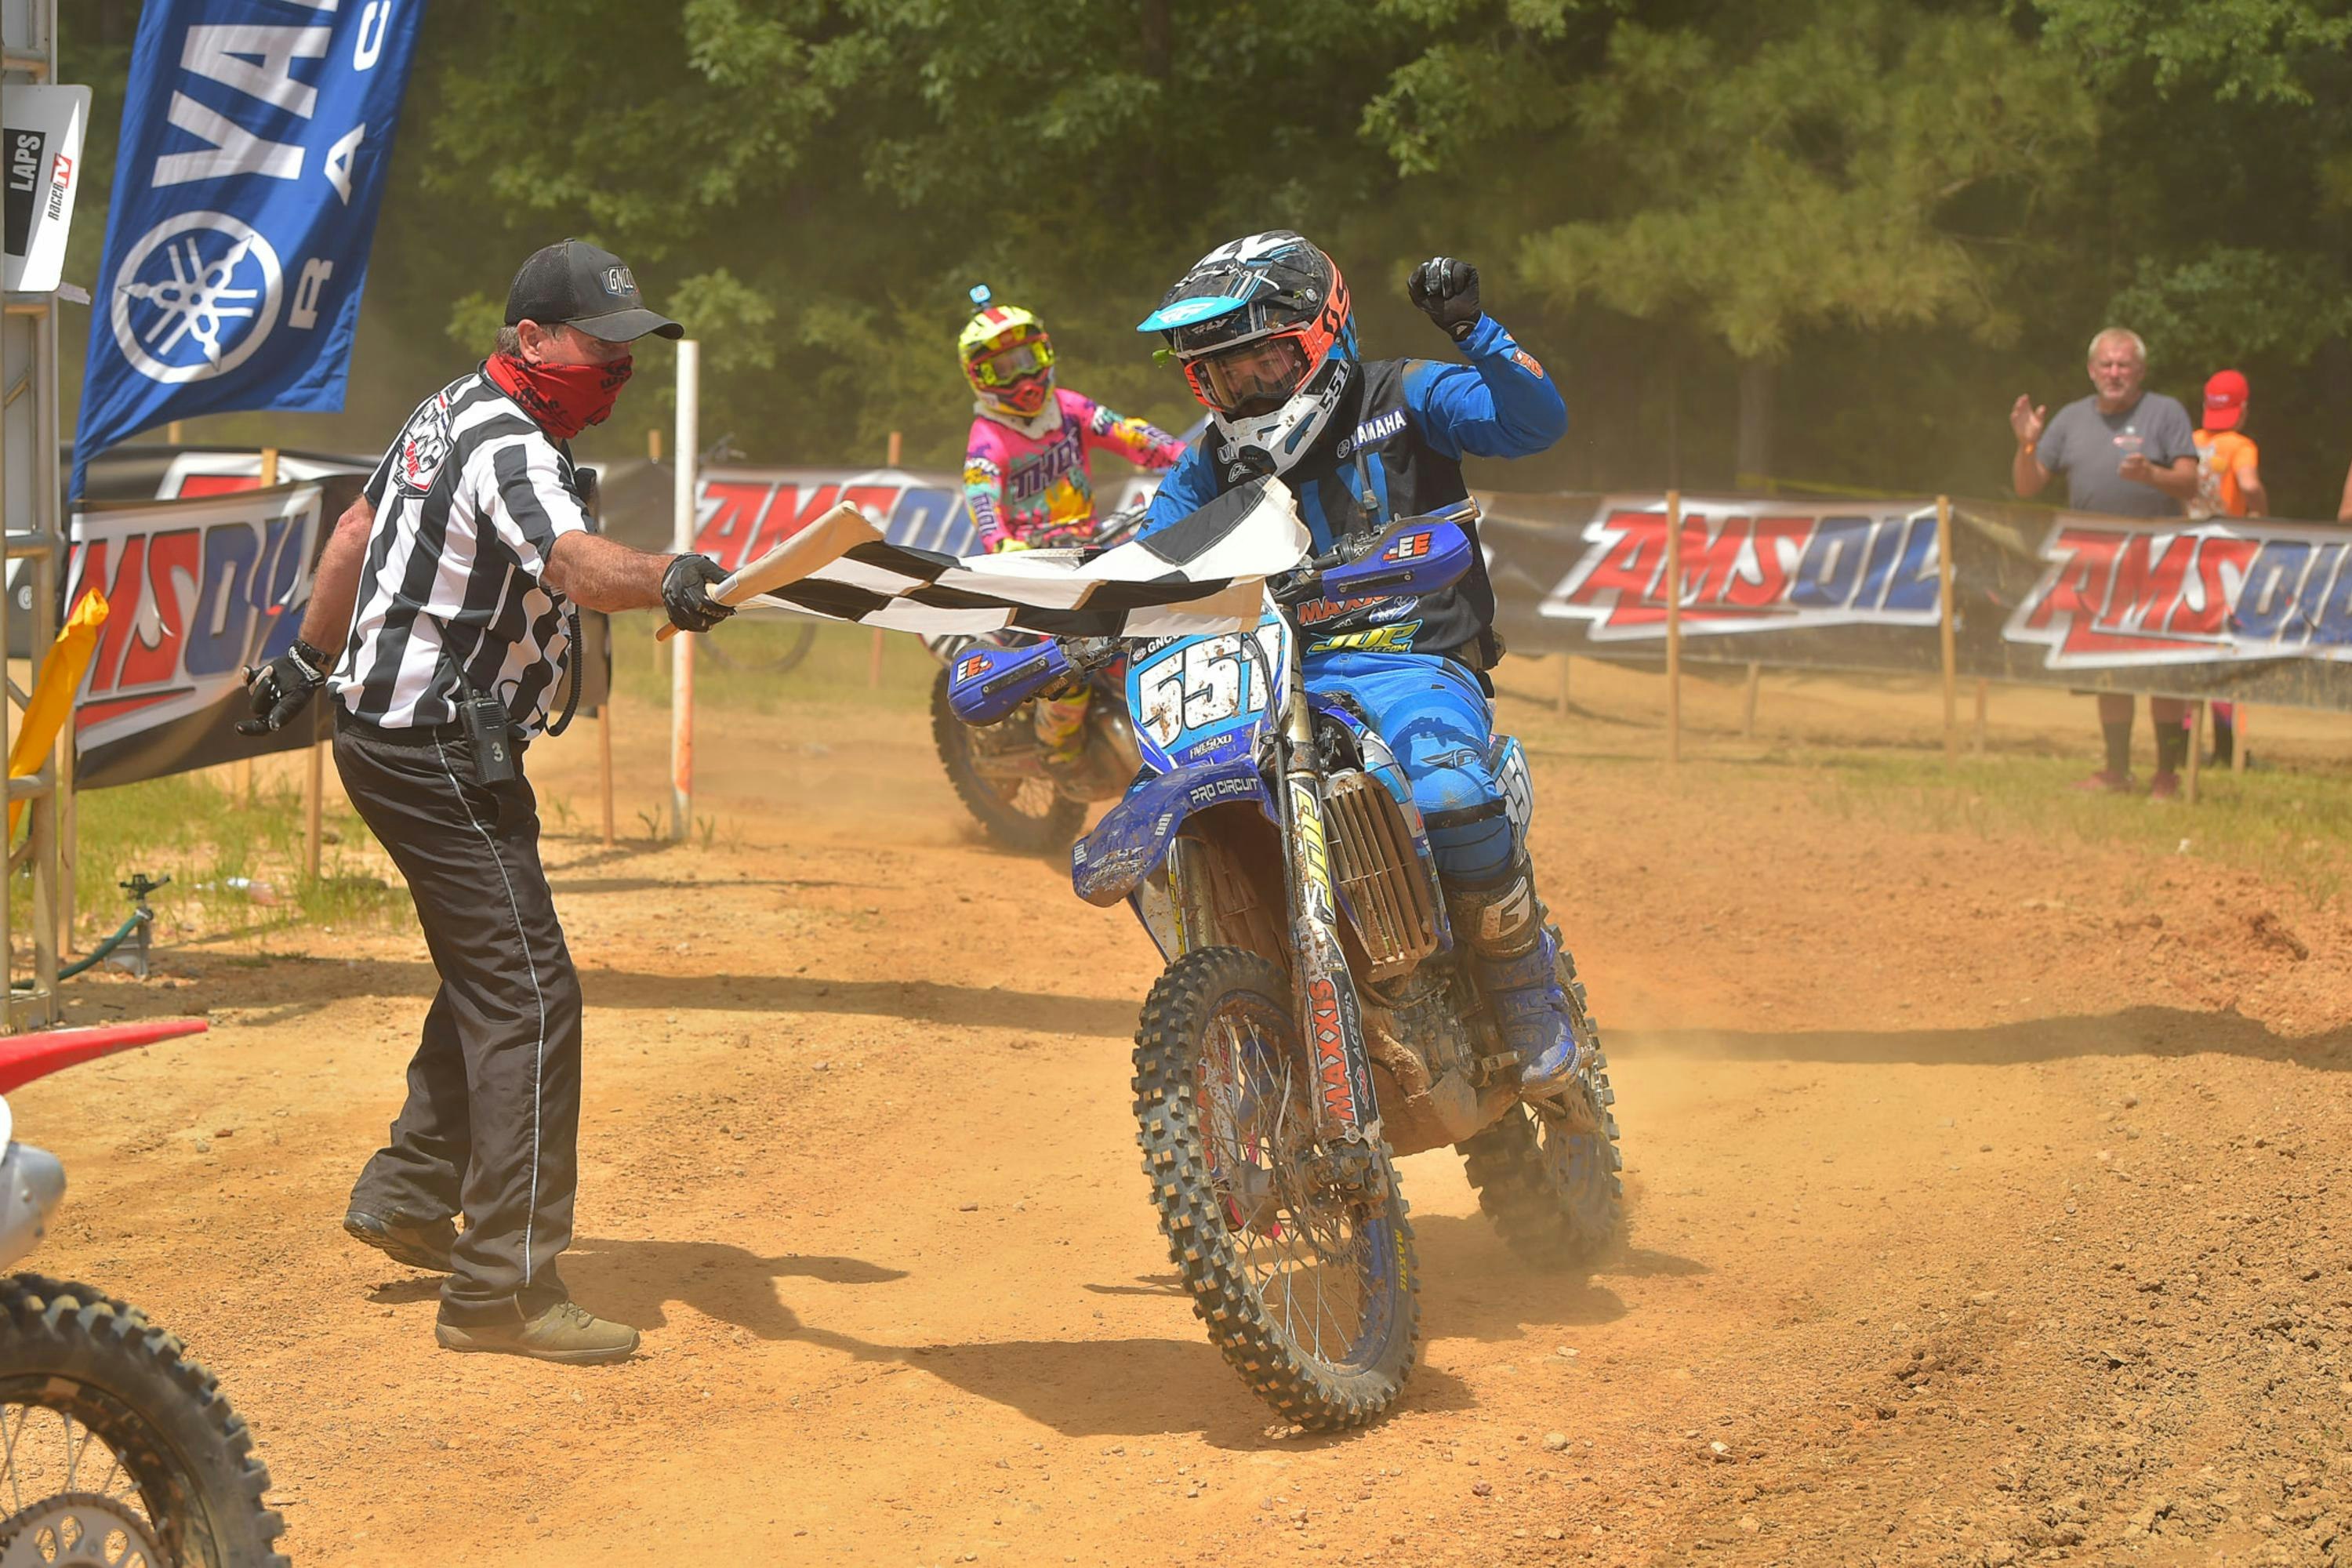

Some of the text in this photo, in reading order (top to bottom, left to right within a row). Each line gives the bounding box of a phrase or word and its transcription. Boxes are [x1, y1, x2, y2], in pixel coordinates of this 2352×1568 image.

[152, 0, 339, 187] YA
[10, 134, 41, 192] LAPS
[1319, 363, 1348, 414] 551
[1351, 409, 1407, 448] YAMAHA
[1568, 510, 1946, 615] AMSOIL
[66, 511, 312, 698] MSOIL
[1139, 623, 1282, 749] 551
[492, 742, 504, 763] 3
[1189, 778, 1258, 804] PRO CIRCUIT
[1308, 978, 1355, 1122] MAXXIS
[1393, 1228, 1408, 1292] MAXXIS
